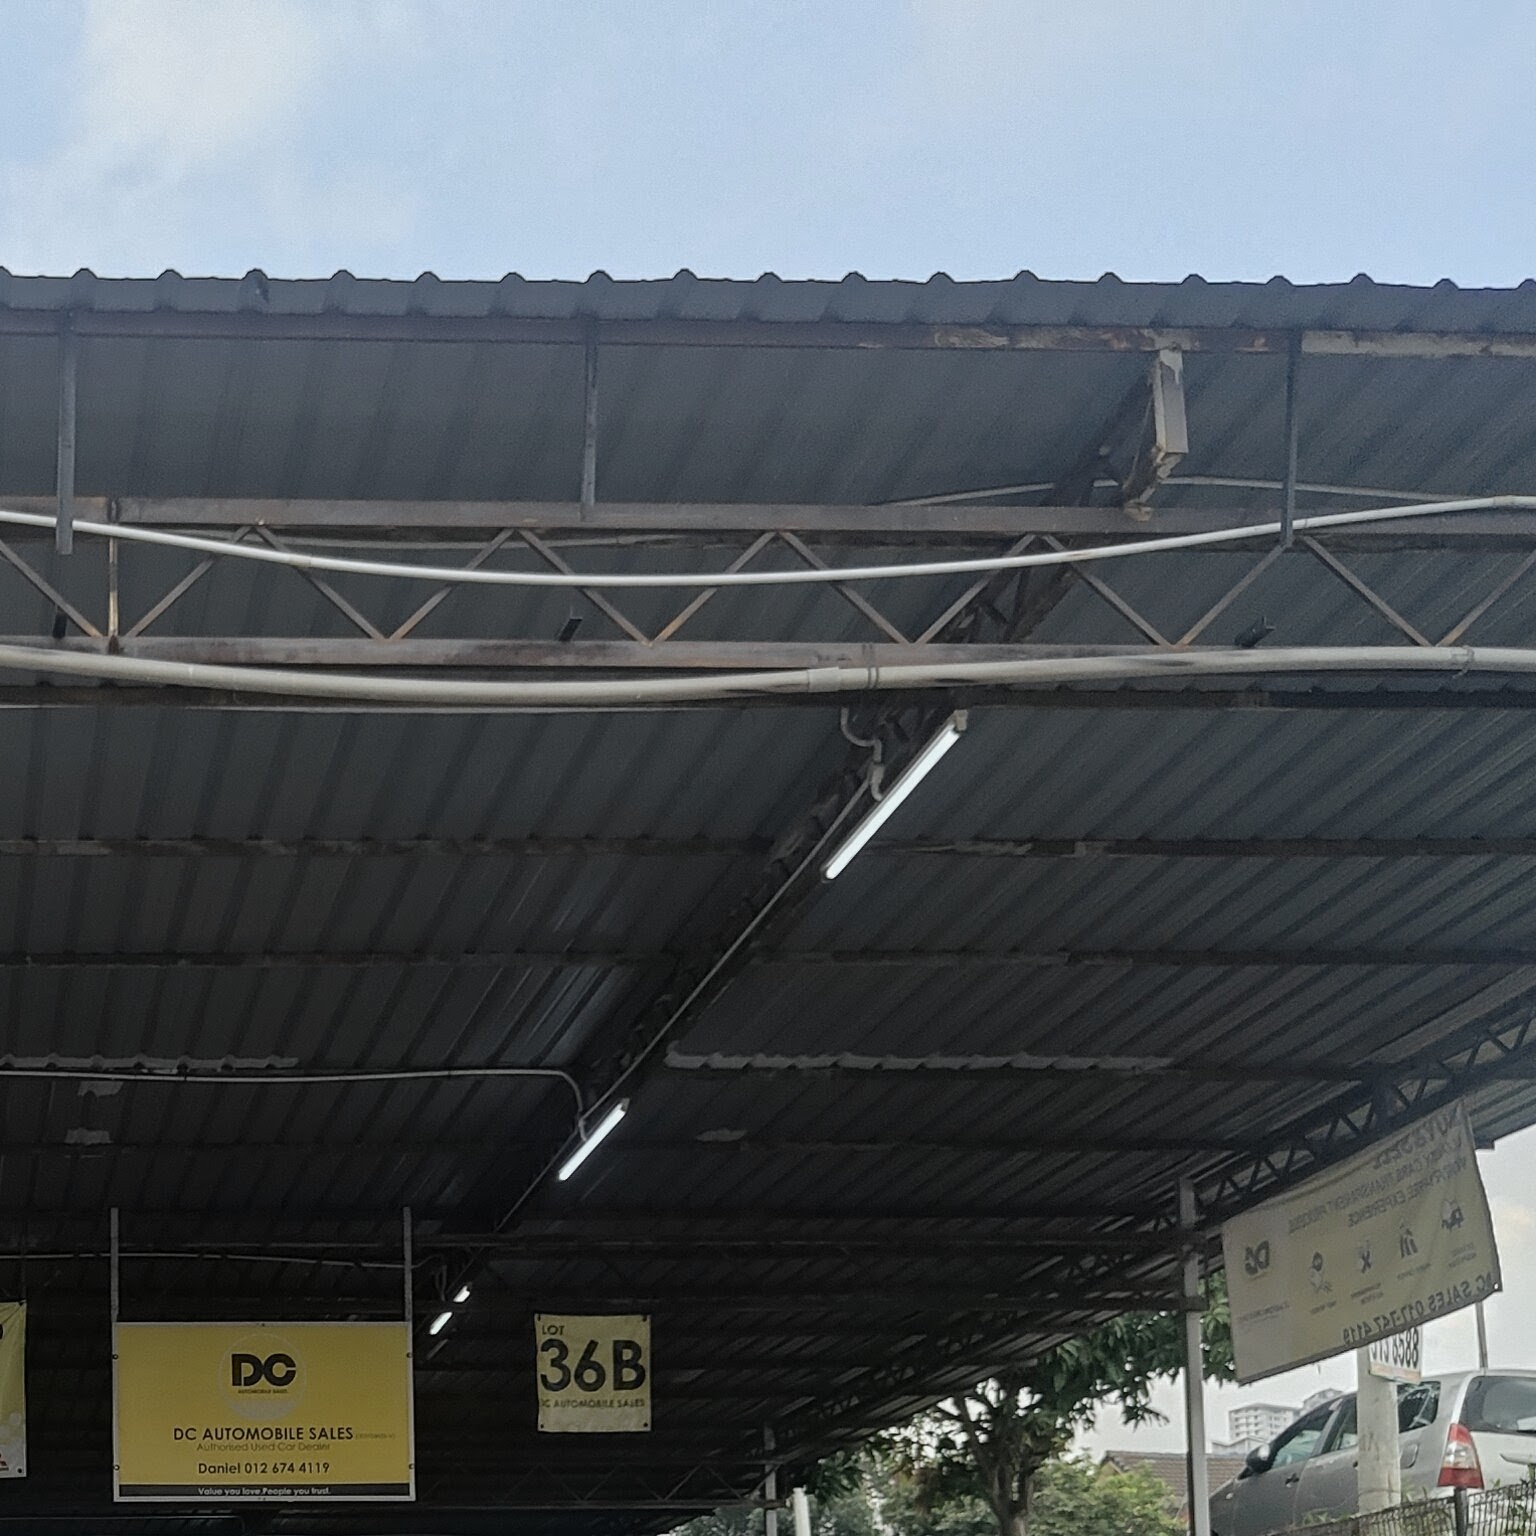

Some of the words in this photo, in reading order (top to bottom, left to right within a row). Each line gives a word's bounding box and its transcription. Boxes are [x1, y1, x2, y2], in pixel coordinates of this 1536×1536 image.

[542, 1325, 565, 1336] LOT
[231, 1353, 297, 1387] DC
[540, 1338, 646, 1392] 36B
[173, 1427, 197, 1441] DC
[202, 1427, 304, 1441] AUTOMOBILE
[309, 1426, 354, 1441] SALES
[196, 1441, 249, 1451] Authorised
[251, 1441, 276, 1451] Used
[277, 1441, 296, 1451] Car
[198, 1462, 241, 1474] Daniel
[244, 1462, 268, 1474] 012
[272, 1462, 295, 1474] 674
[298, 1462, 330, 1474] 4119
[198, 1487, 223, 1495] Value
[224, 1488, 241, 1497] you
[293, 1488, 310, 1497] you
